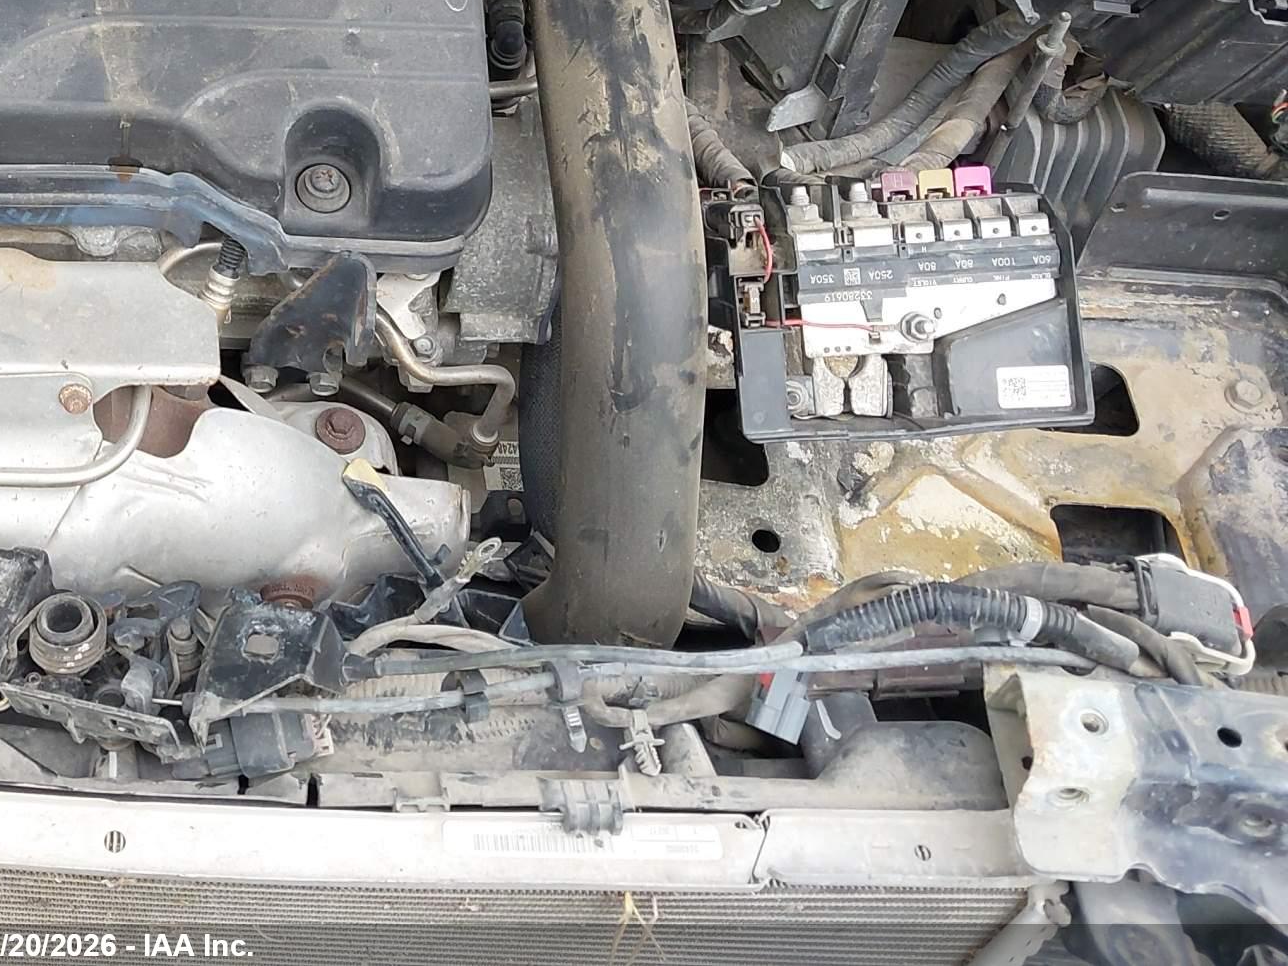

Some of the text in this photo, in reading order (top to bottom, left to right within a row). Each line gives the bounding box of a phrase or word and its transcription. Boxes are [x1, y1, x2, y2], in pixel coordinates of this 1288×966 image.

[954, 258, 974, 268] 80A
[992, 256, 1016, 266] 100A
[1032, 254, 1052, 264] 60A
[918, 262, 937, 272] 80A
[810, 274, 834, 284] 350A
[868, 270, 894, 280] 250A
[824, 290, 872, 302] 33280619
